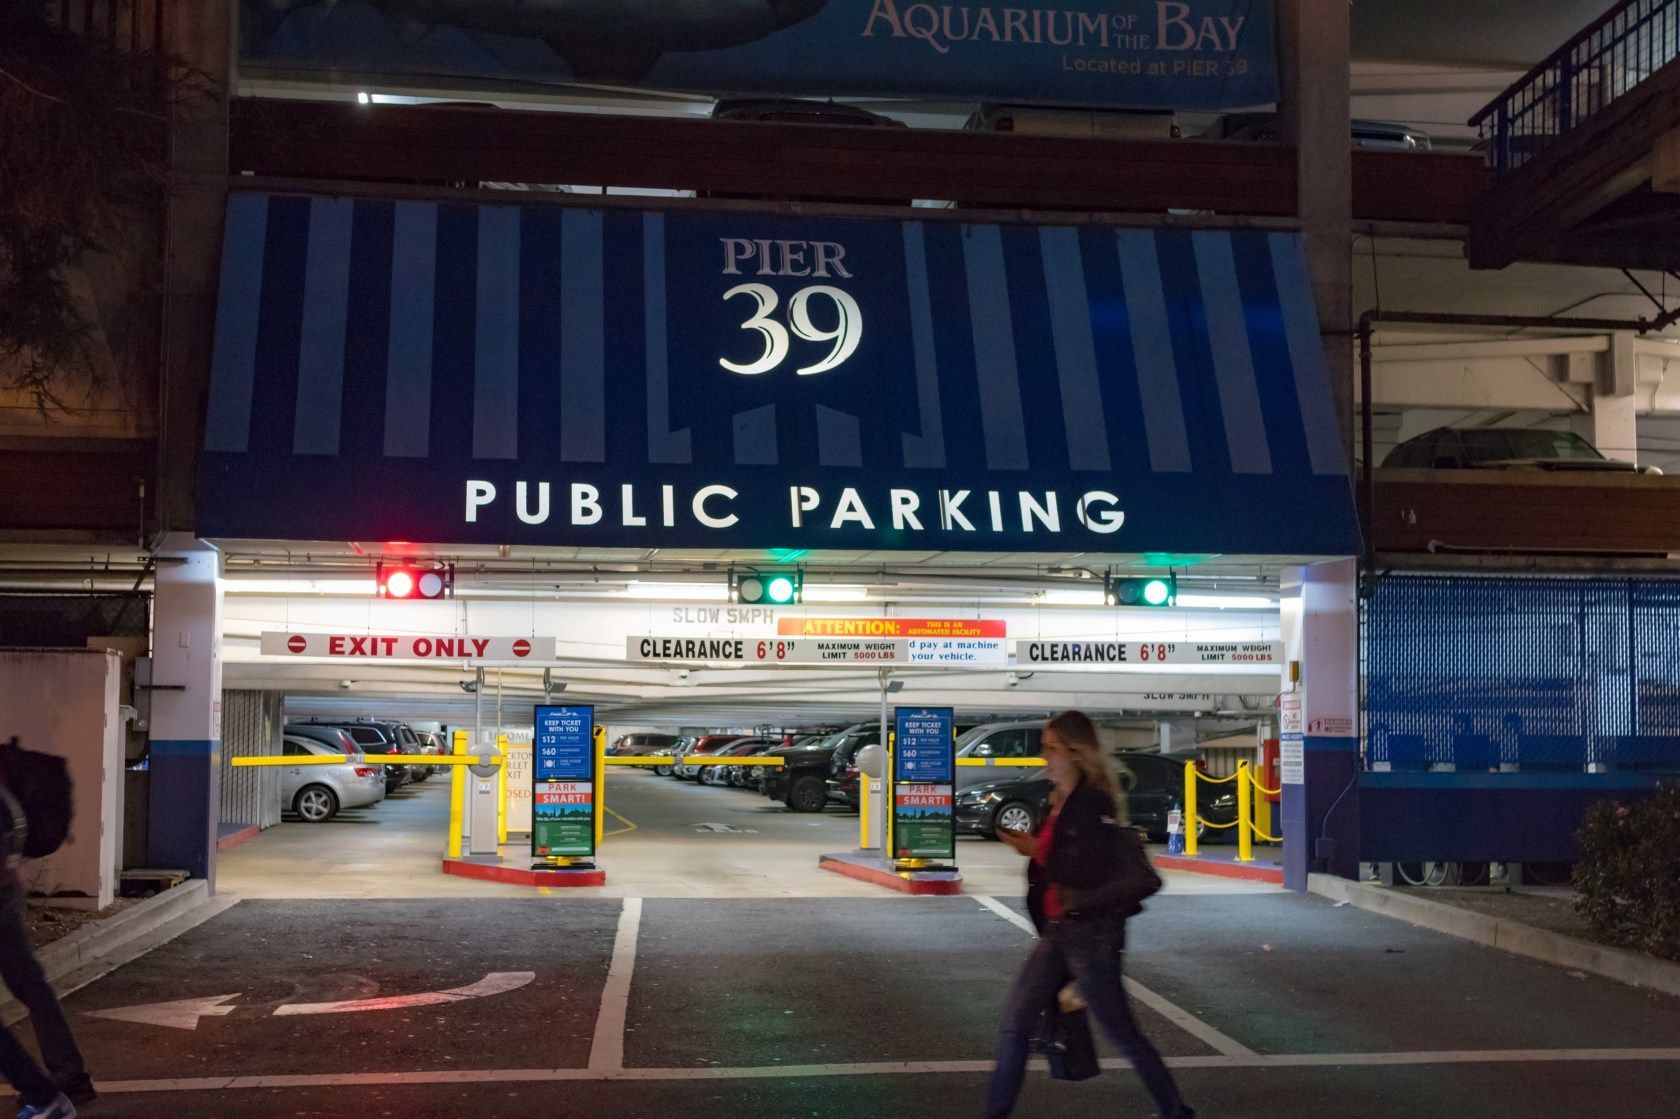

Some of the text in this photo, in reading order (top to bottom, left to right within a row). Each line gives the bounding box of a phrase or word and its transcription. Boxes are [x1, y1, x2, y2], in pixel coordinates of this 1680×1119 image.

[1112, 14, 1138, 30] OF
[1114, 32, 1150, 50] THE
[1061, 54, 1141, 75] Located
[1149, 57, 1168, 76] at
[1174, 59, 1218, 77] PIER
[720, 238, 853, 278] PIER
[719, 283, 862, 375] 39
[465, 480, 1125, 533] PUBLIC PARKING
[672, 607, 774, 625] SLOW 5MPH
[802, 619, 900, 635] ATTENTION:
[329, 636, 490, 657] EXIT ONLY
[640, 638, 743, 660] CLEARANCE
[817, 642, 896, 650] MAXIMUM WEIGHT
[920, 641, 939, 651] pay
[943, 641, 953, 649] at
[957, 640, 999, 649] machine
[1029, 643, 1127, 662] CLEARANCE
[911, 652, 977, 662] your vehicle.
[1201, 653, 1272, 661] LIMIT 5000 LBS
[542, 735, 556, 743] $12
[549, 783, 577, 791] PARK
[909, 785, 937, 793] PARK
[543, 794, 585, 803] SMART!
[904, 796, 945, 805] SMART!
